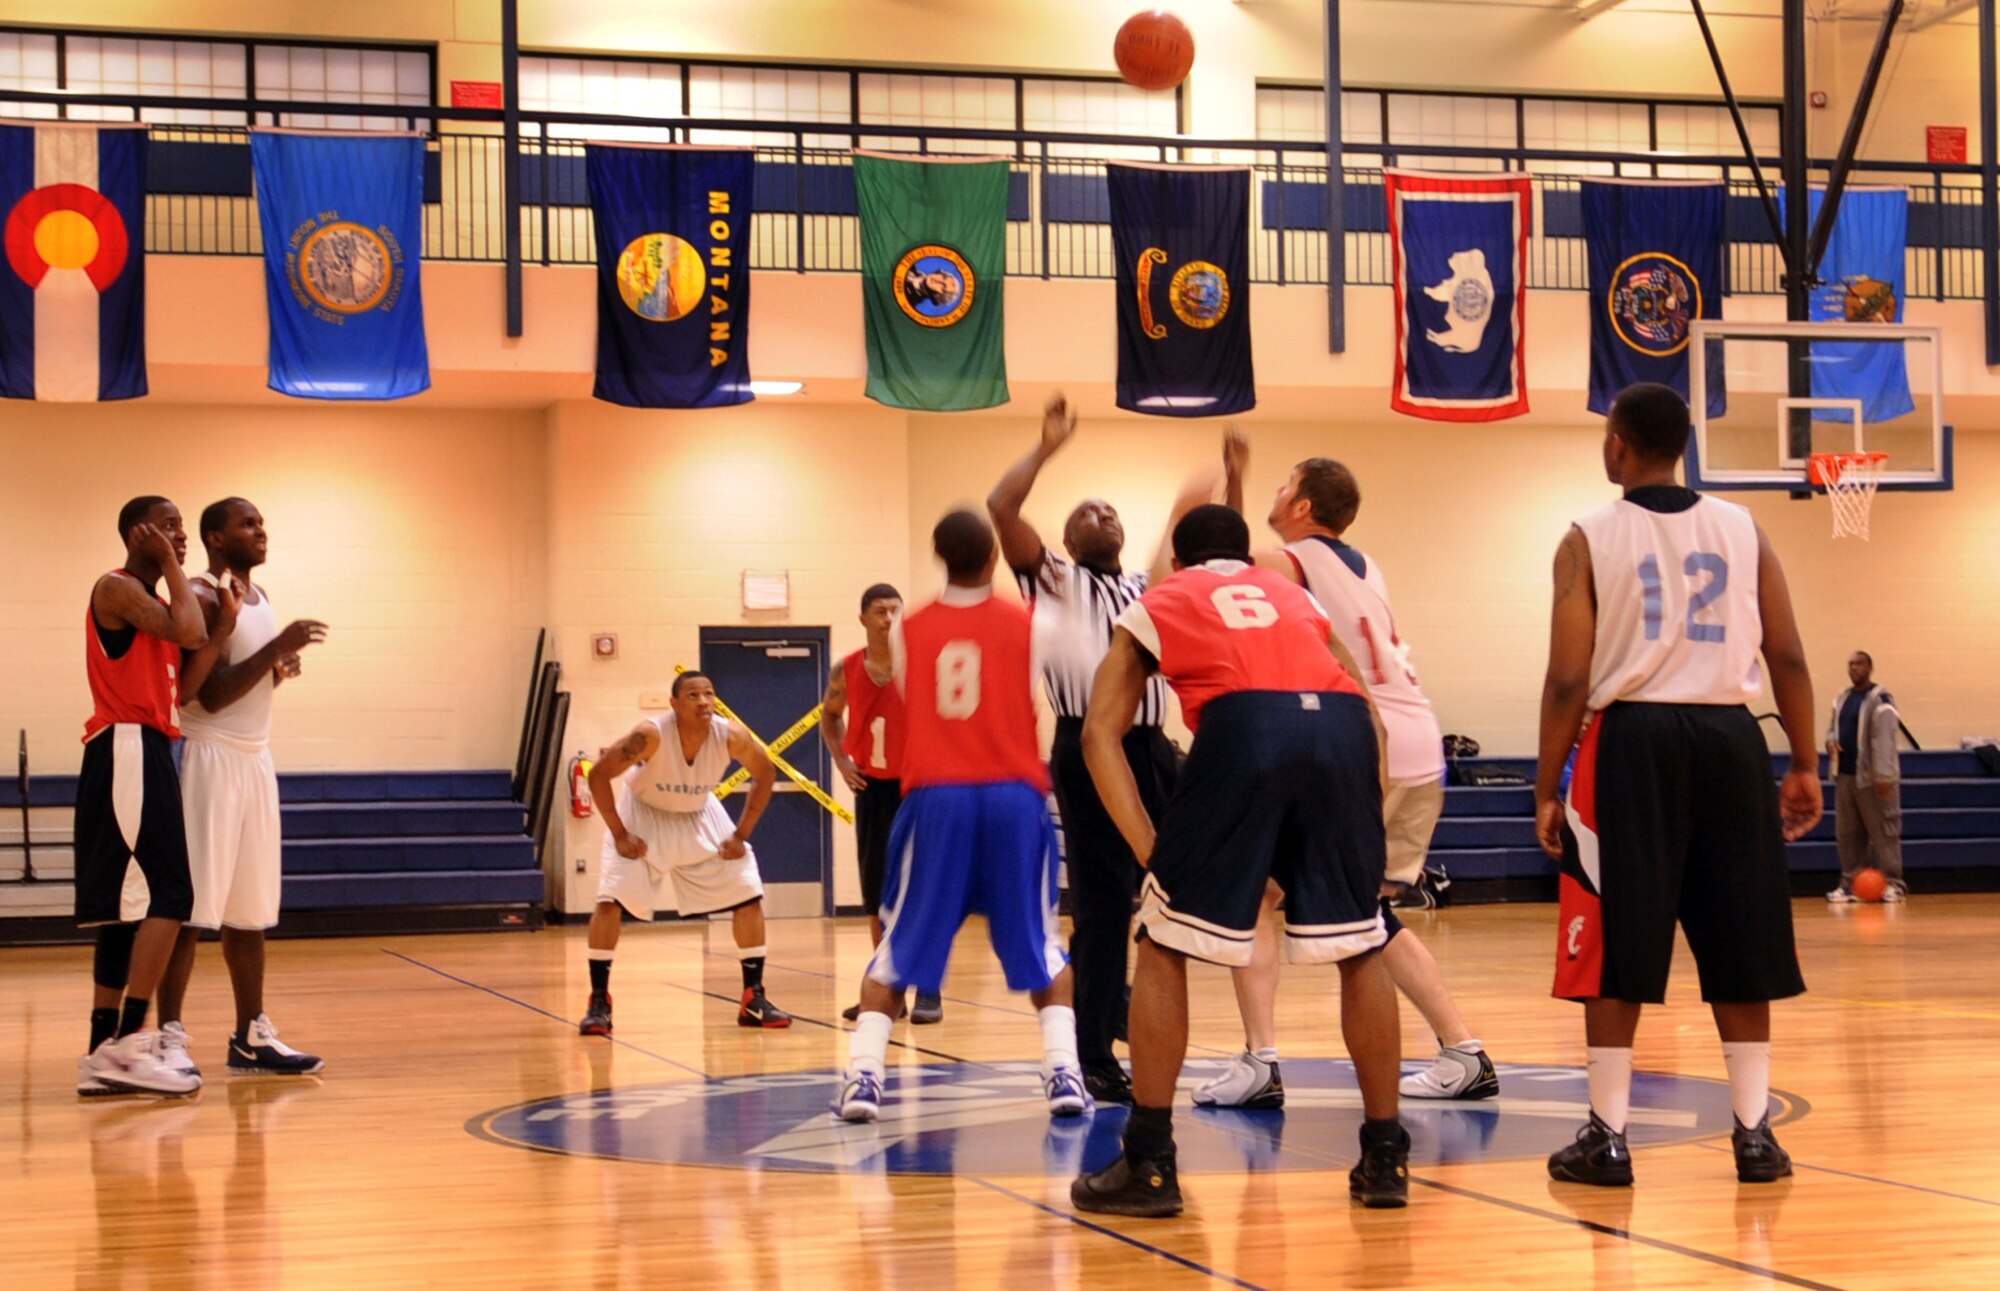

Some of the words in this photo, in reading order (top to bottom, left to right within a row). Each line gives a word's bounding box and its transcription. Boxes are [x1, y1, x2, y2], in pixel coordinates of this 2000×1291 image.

[709, 191, 731, 367] MONTANA
[1209, 584, 1279, 630] 6
[1638, 551, 1728, 643] 12
[935, 639, 982, 721] 8
[771, 723, 807, 754] CAUTION
[870, 716, 888, 770] 1
[797, 774, 831, 806] CAUTION
